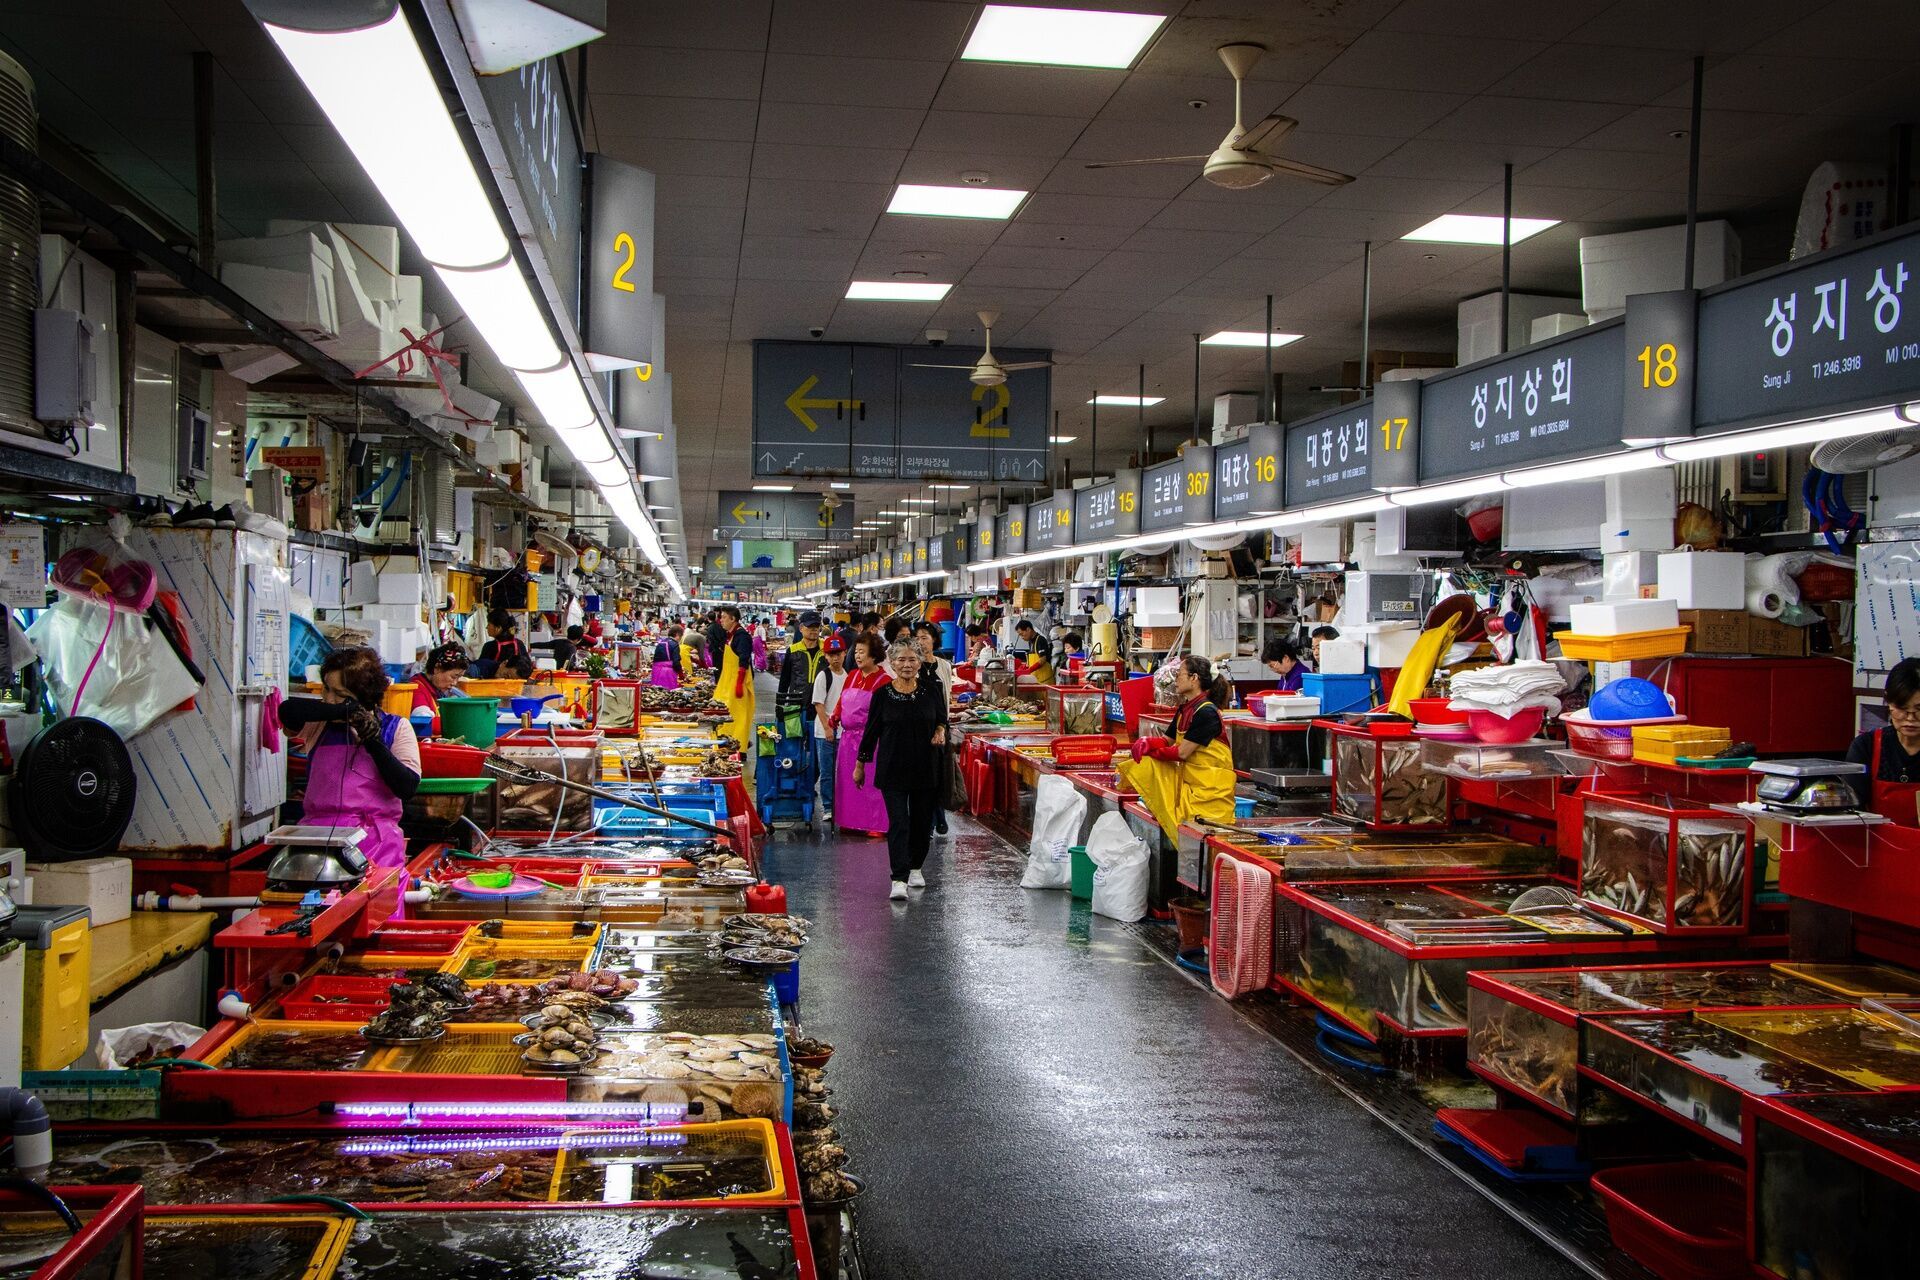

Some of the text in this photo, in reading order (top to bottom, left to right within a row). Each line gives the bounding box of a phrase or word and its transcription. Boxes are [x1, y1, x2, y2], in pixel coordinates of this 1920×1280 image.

[612, 232, 636, 293] 2
[1764, 262, 1908, 358] 성지상
[1637, 344, 1678, 389] 18
[1763, 374, 1782, 389] Sung
[1783, 371, 1791, 385] Ji
[1823, 355, 1861, 378] 246.3918
[1471, 358, 1572, 428] 성지상회
[970, 384, 1010, 438] 2
[1306, 418, 1368, 468] 대흥상회
[1381, 418, 1408, 451] 17
[1255, 456, 1275, 482] 16
[1187, 472, 1209, 496] 367
[1119, 492, 1134, 512] 15
[1010, 521, 1021, 536] 13
[1056, 509, 1070, 526] 14
[957, 538, 964, 551] 11
[981, 530, 991, 545] 12
[883, 559, 891, 568] 73
[903, 552, 912, 563] 74
[917, 548, 926, 559] 75
[864, 564, 869, 572] 71
[871, 561, 878, 570] 72
